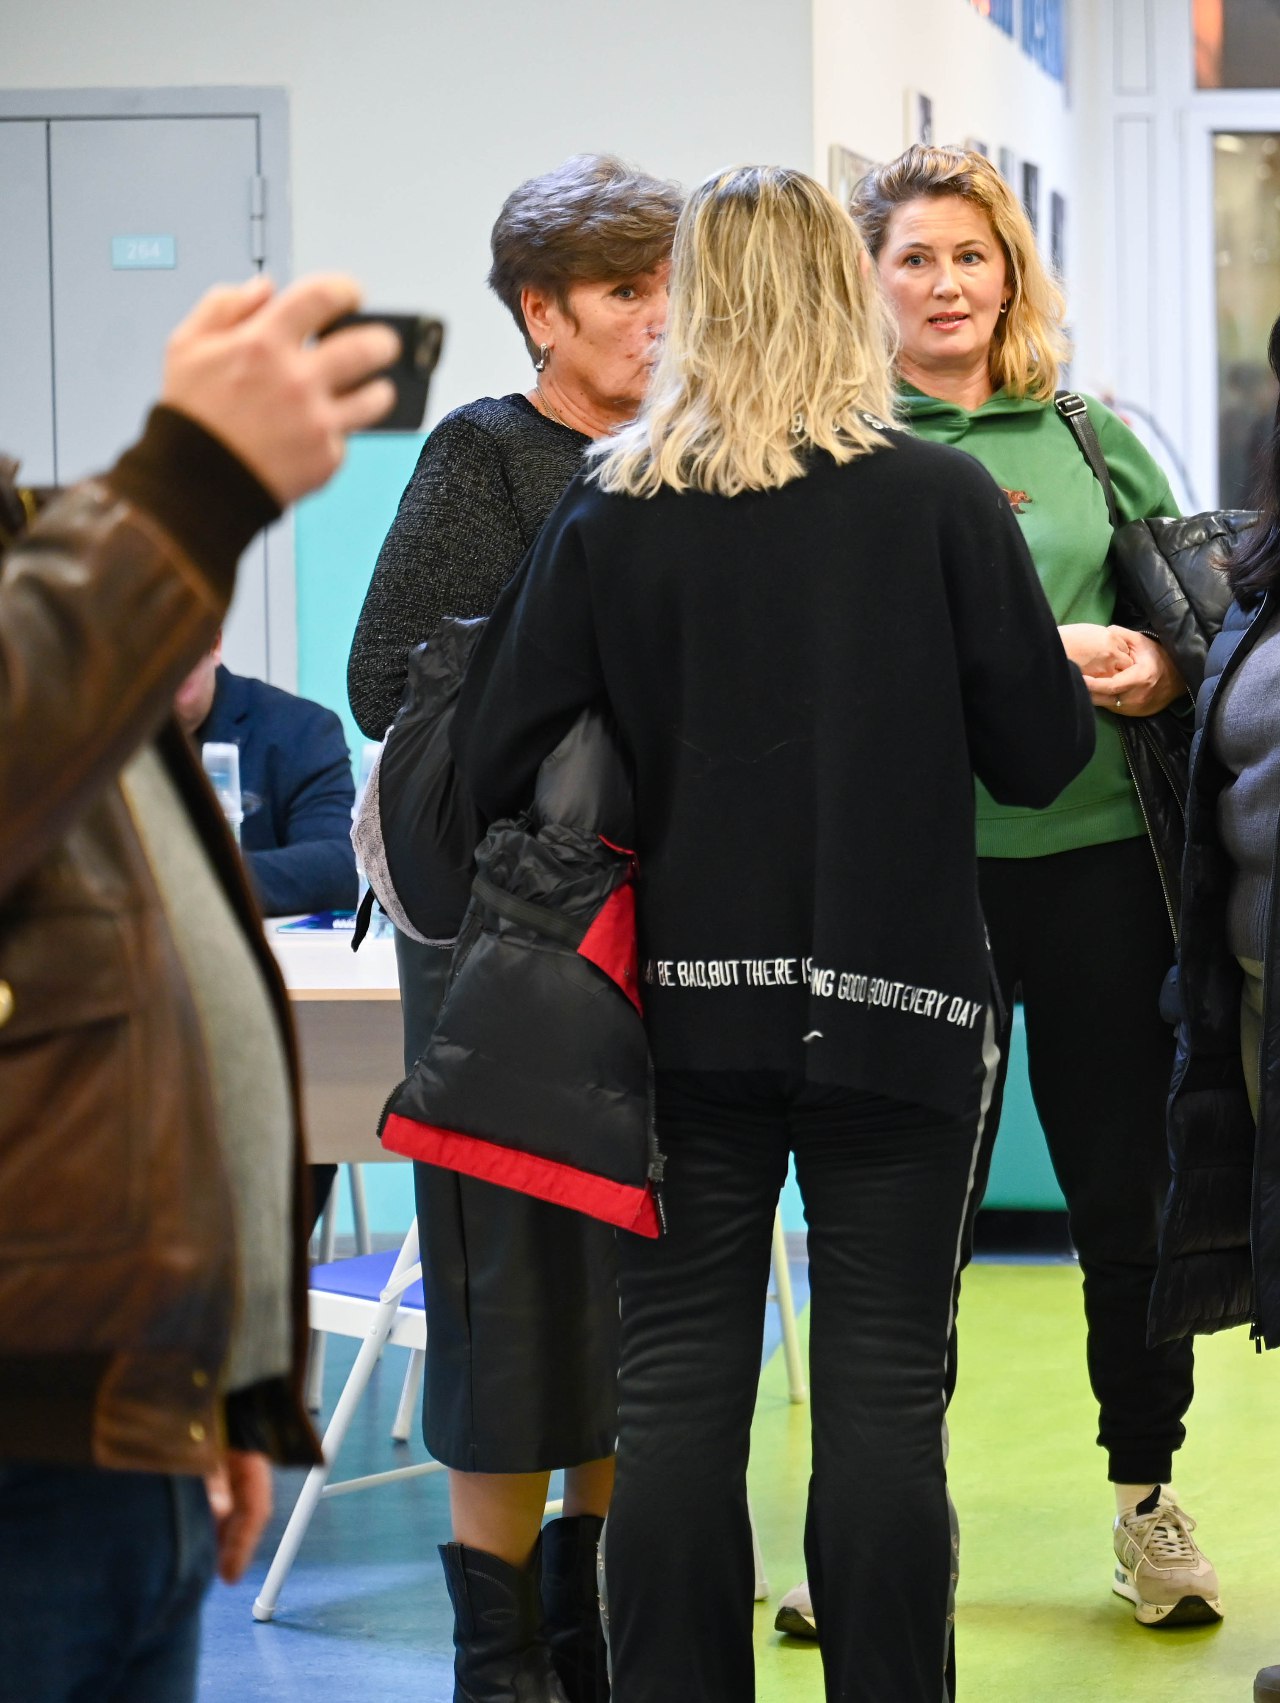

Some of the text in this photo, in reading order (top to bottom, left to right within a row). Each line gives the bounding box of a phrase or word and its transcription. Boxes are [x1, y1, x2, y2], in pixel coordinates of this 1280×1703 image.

[657, 960, 675, 987] BE
[741, 957, 798, 987] THERE
[900, 985, 949, 1020] EVERY
[947, 996, 982, 1030] DAY
